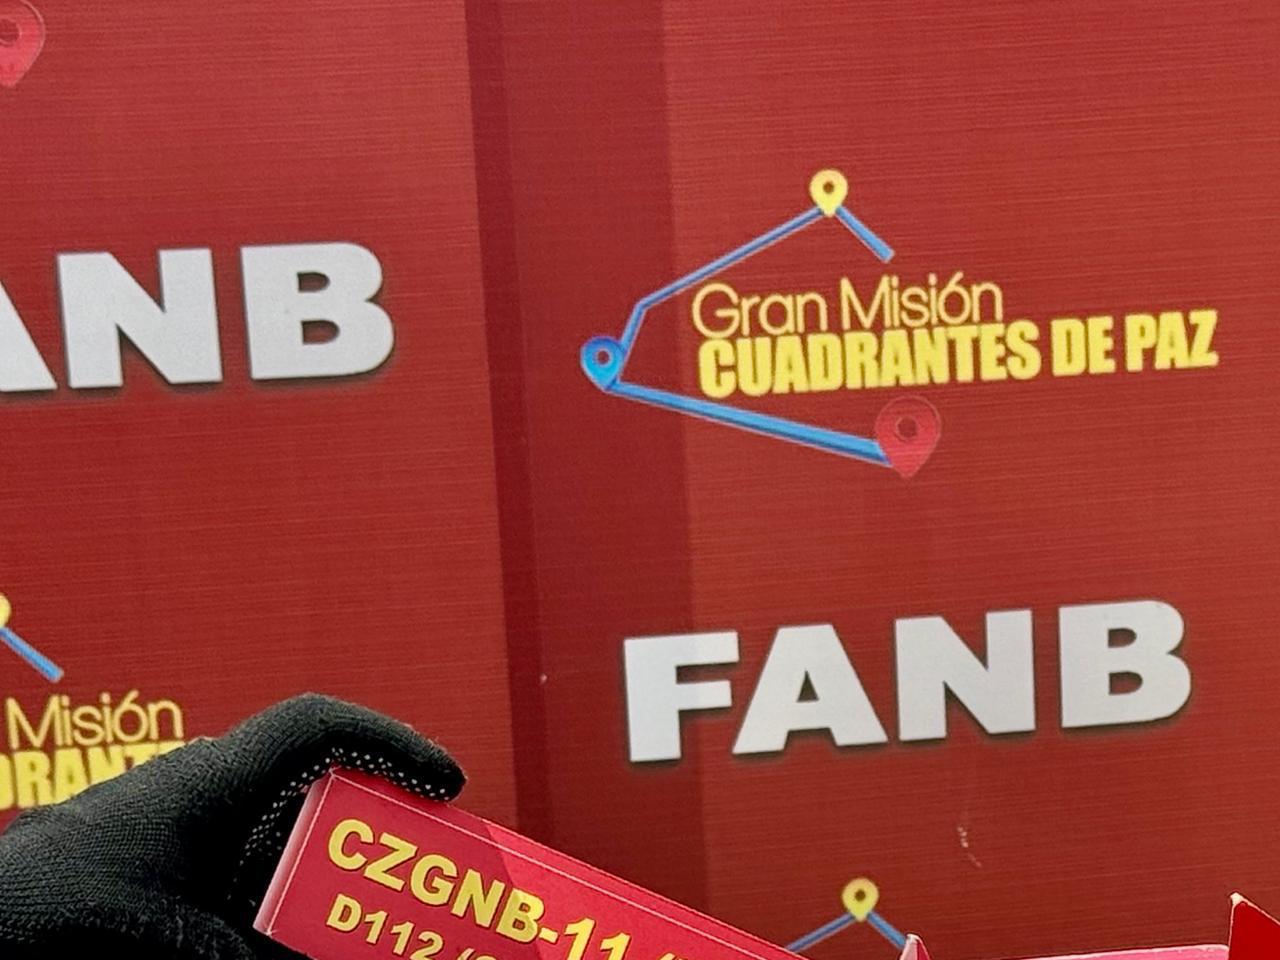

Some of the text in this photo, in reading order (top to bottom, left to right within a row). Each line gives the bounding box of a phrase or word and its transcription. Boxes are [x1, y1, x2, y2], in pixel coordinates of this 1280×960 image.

[691, 271, 1003, 340] Gran Misión
[698, 309, 1219, 398] CUADRANTES DE PAZ
[6, 690, 184, 749] Misión
[623, 600, 1192, 762] FANB
